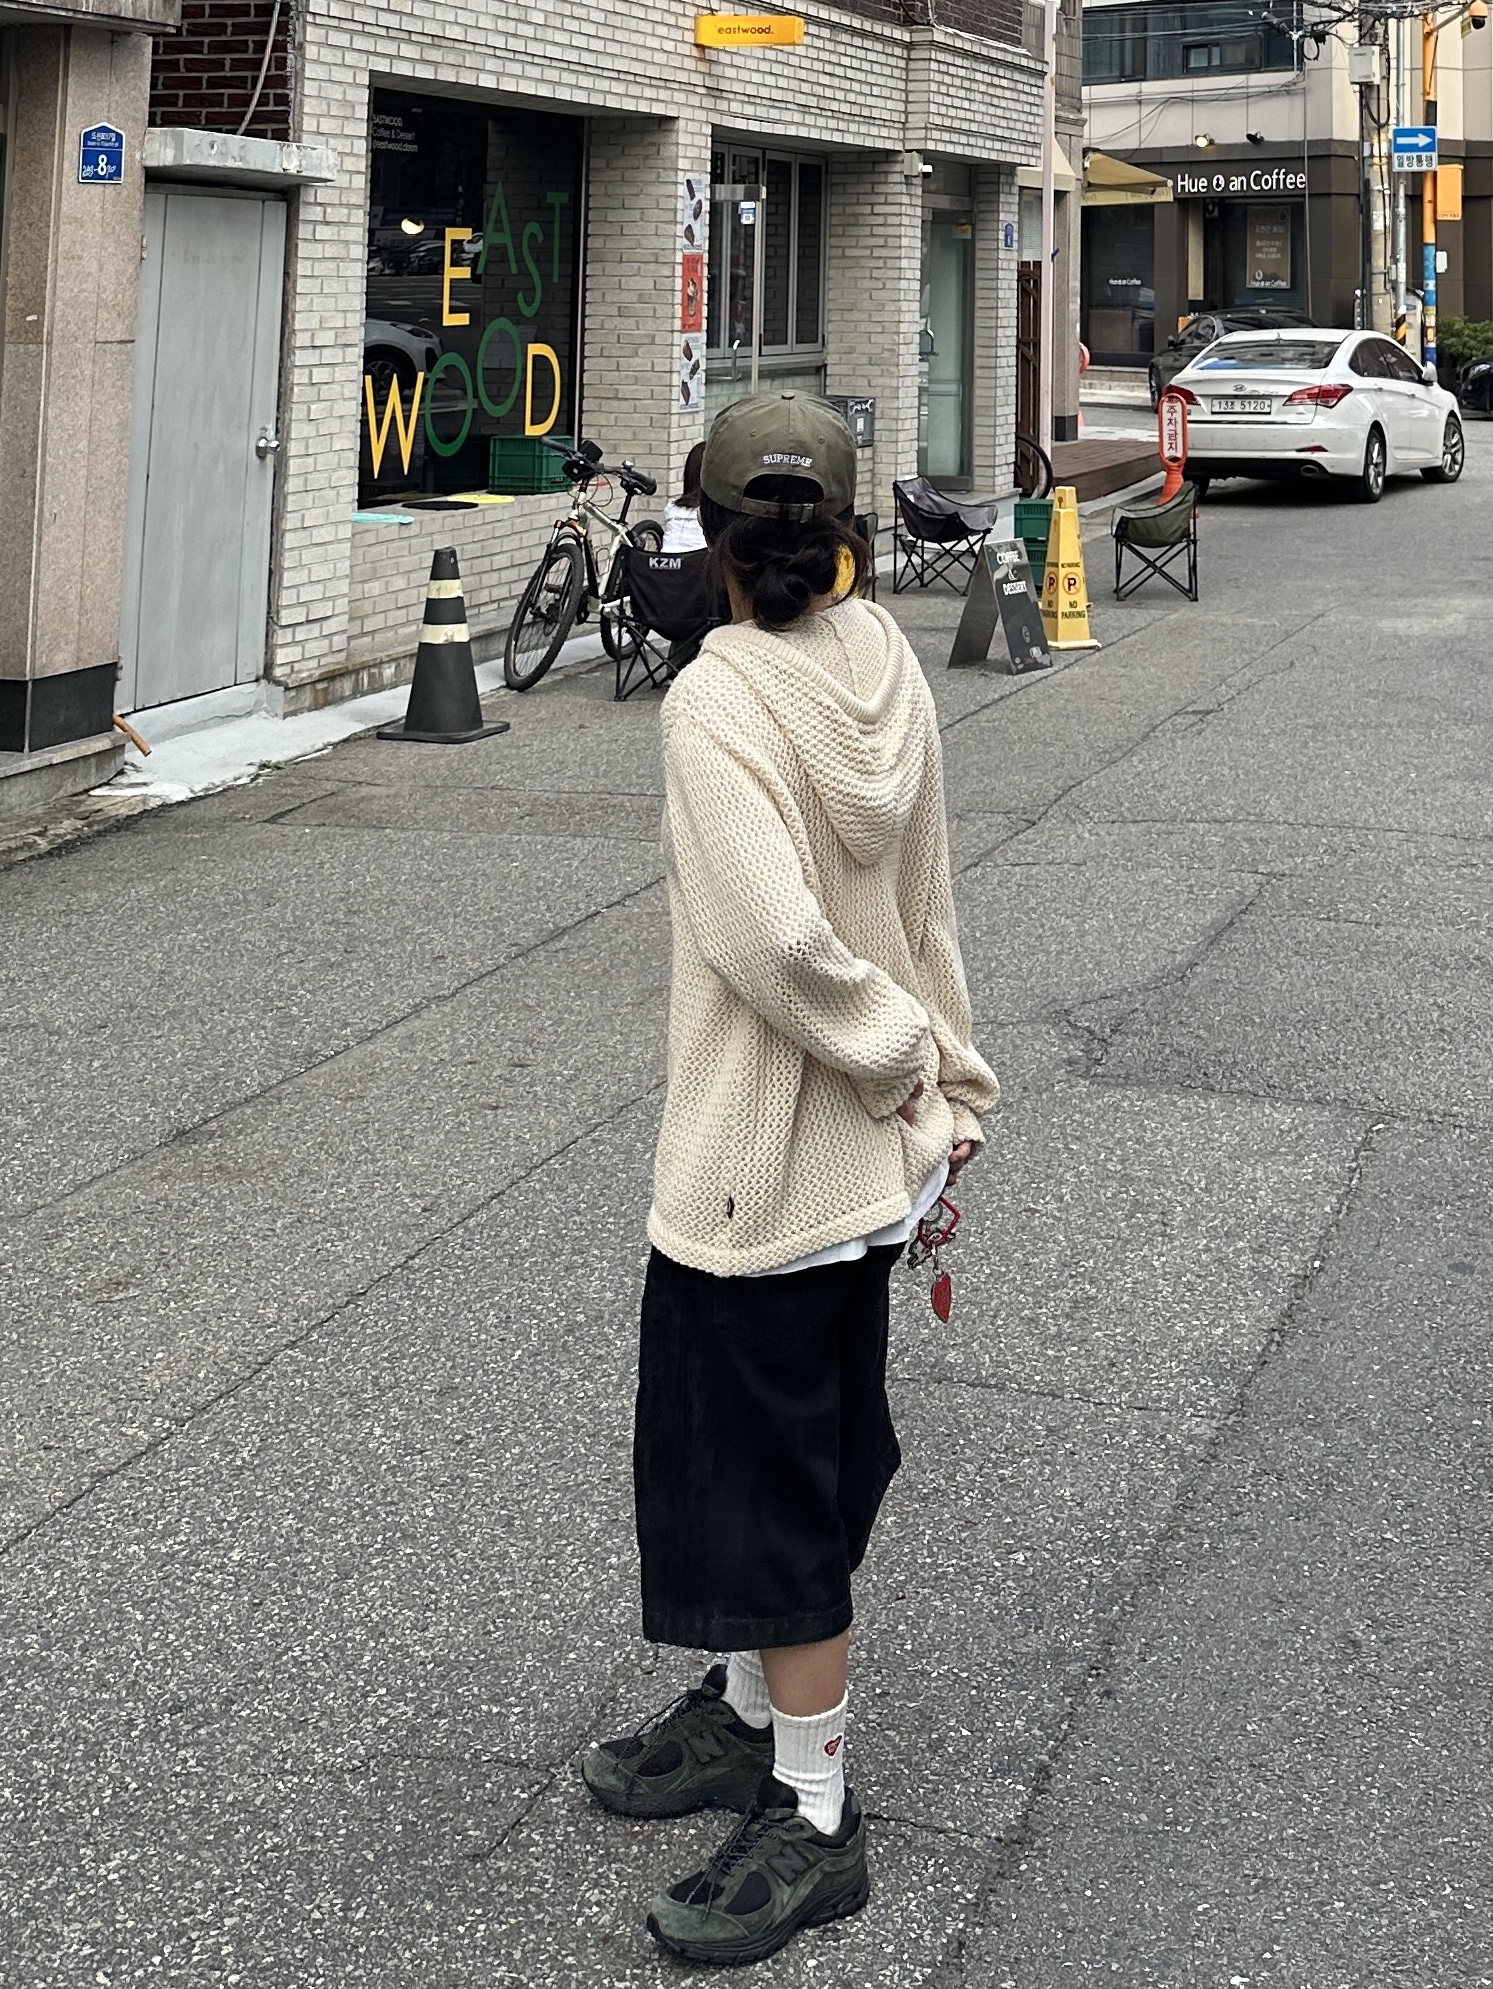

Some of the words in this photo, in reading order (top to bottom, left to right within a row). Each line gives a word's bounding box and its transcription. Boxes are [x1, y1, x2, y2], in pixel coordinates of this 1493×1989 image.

[717, 24, 775, 35] eastwood.
[1396, 154, 1434, 168] 일방통행
[1177, 173, 1208, 193] Hue
[1228, 175, 1248, 191] an
[1249, 168, 1306, 191] Coffee
[1239, 400, 1267, 411] 5120
[1166, 404, 1179, 454] 주차금지
[763, 453, 813, 467] SUPREME
[648, 556, 682, 570] KZM
[1068, 600, 1078, 609] NO
[1061, 610, 1086, 620] PARKING
